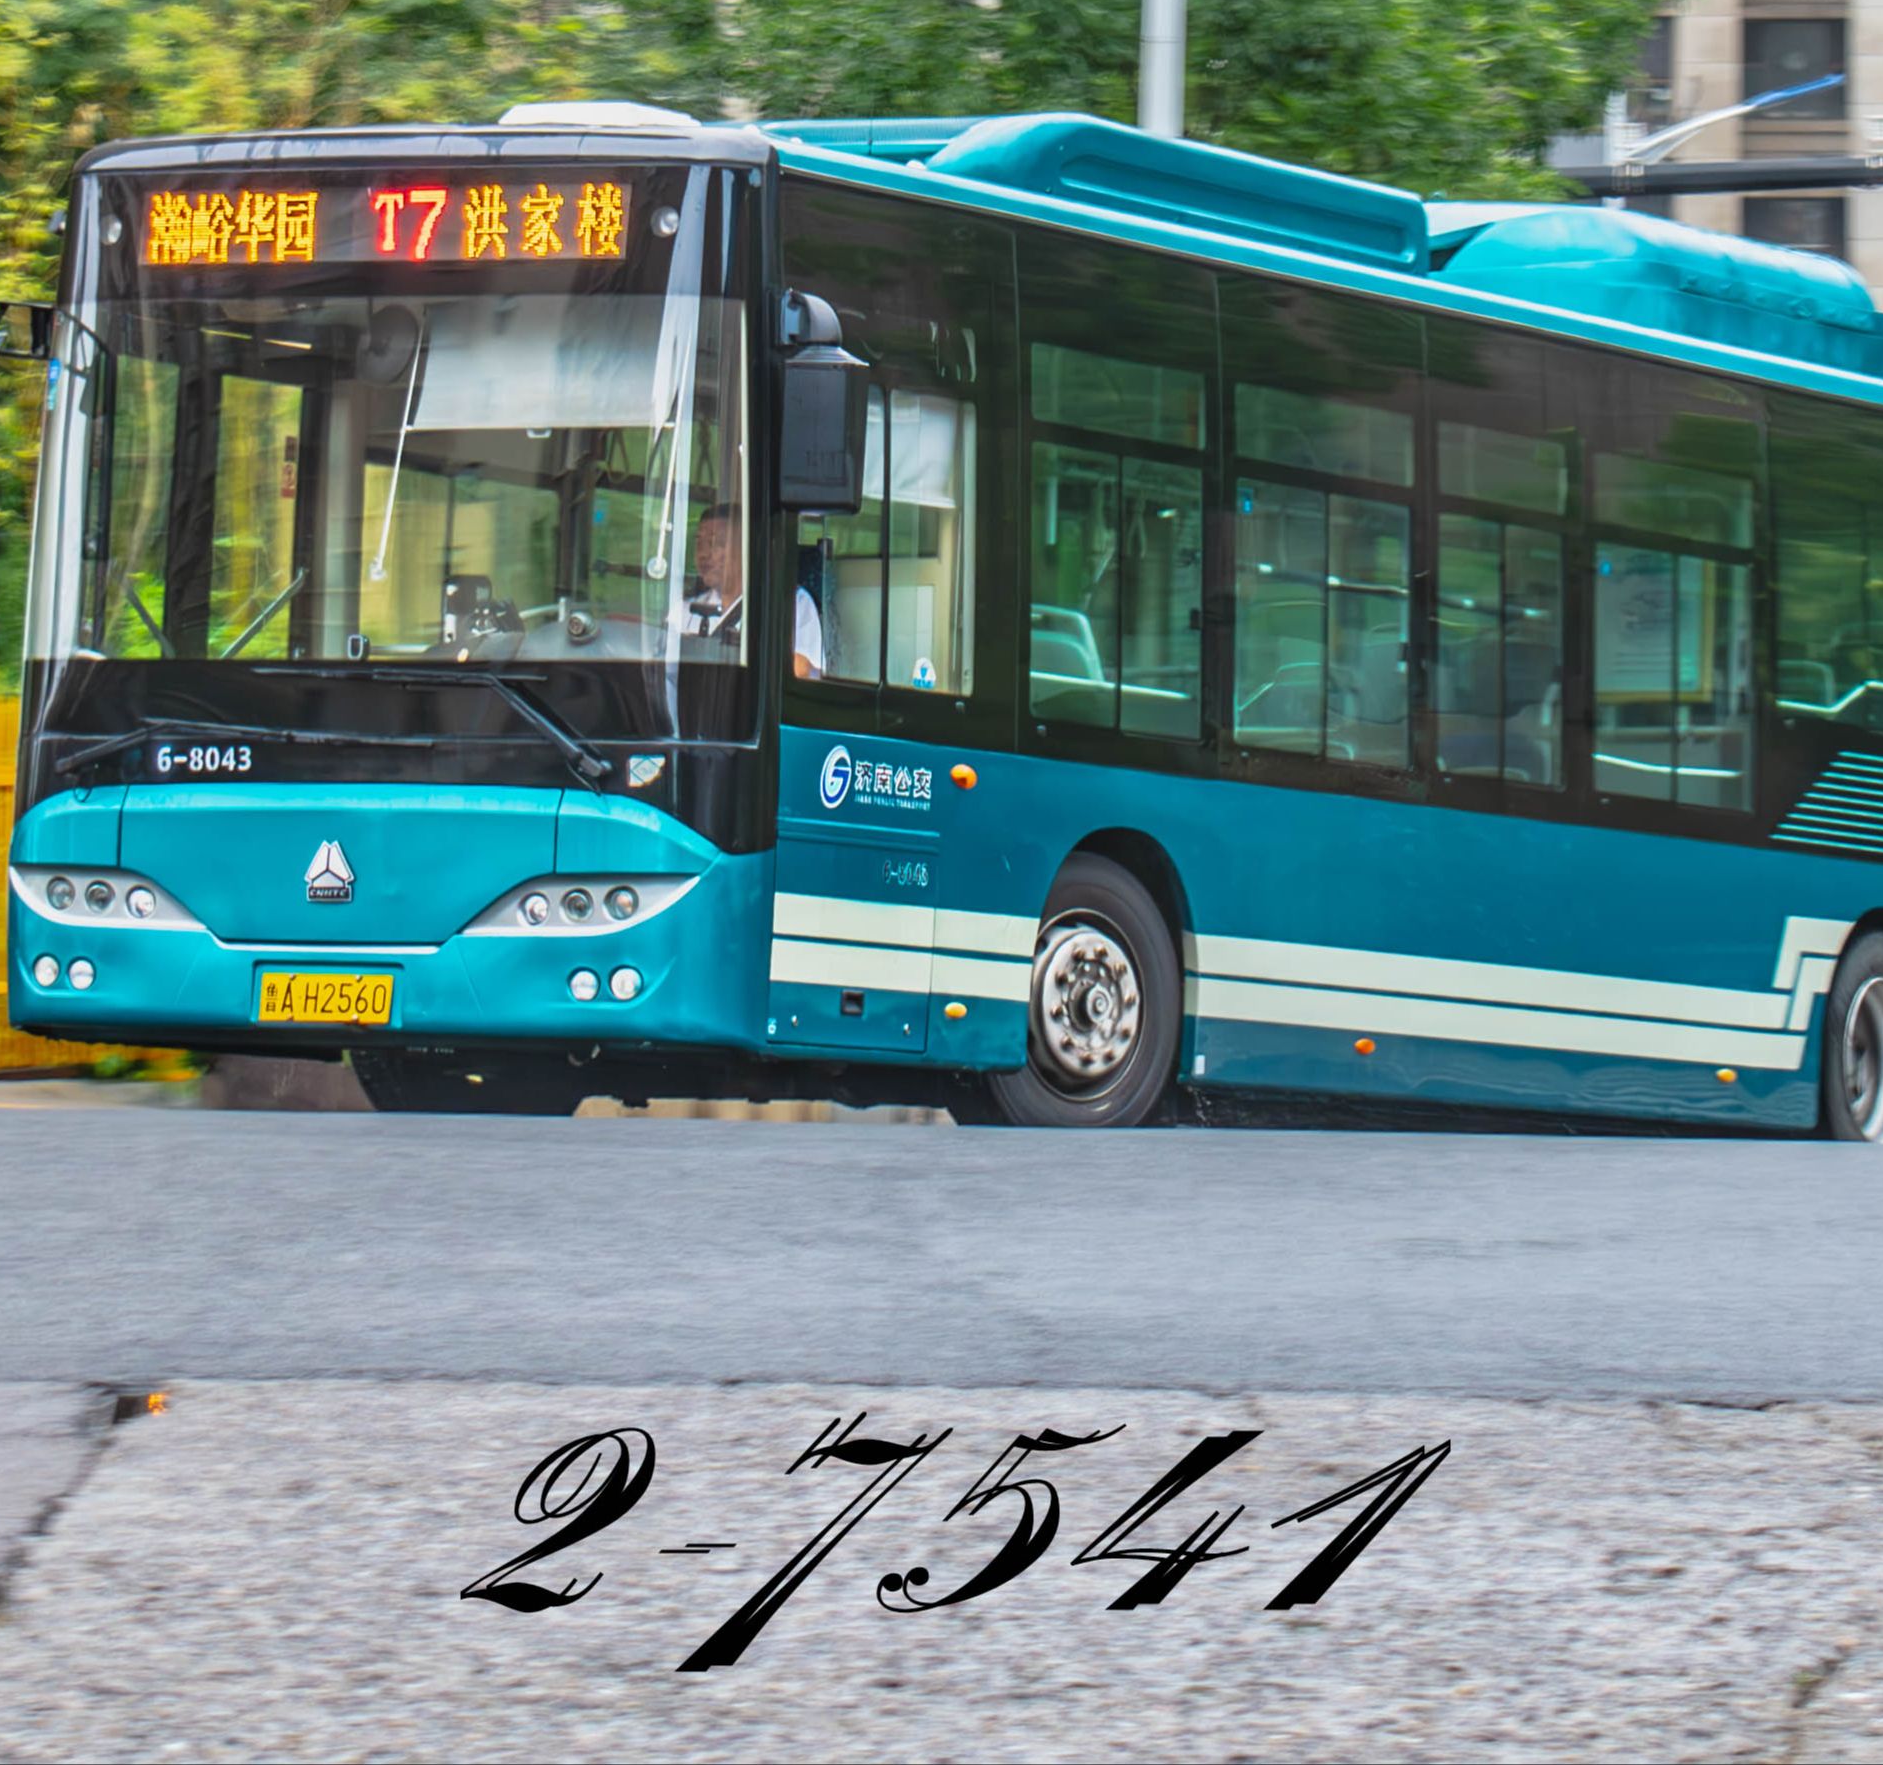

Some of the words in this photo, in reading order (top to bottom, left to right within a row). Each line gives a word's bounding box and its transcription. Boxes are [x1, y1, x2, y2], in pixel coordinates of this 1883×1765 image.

[374, 190, 448, 260] T7
[463, 182, 624, 259] 洪家楼
[157, 745, 252, 772] 6-8043
[854, 760, 933, 799] 济南公交
